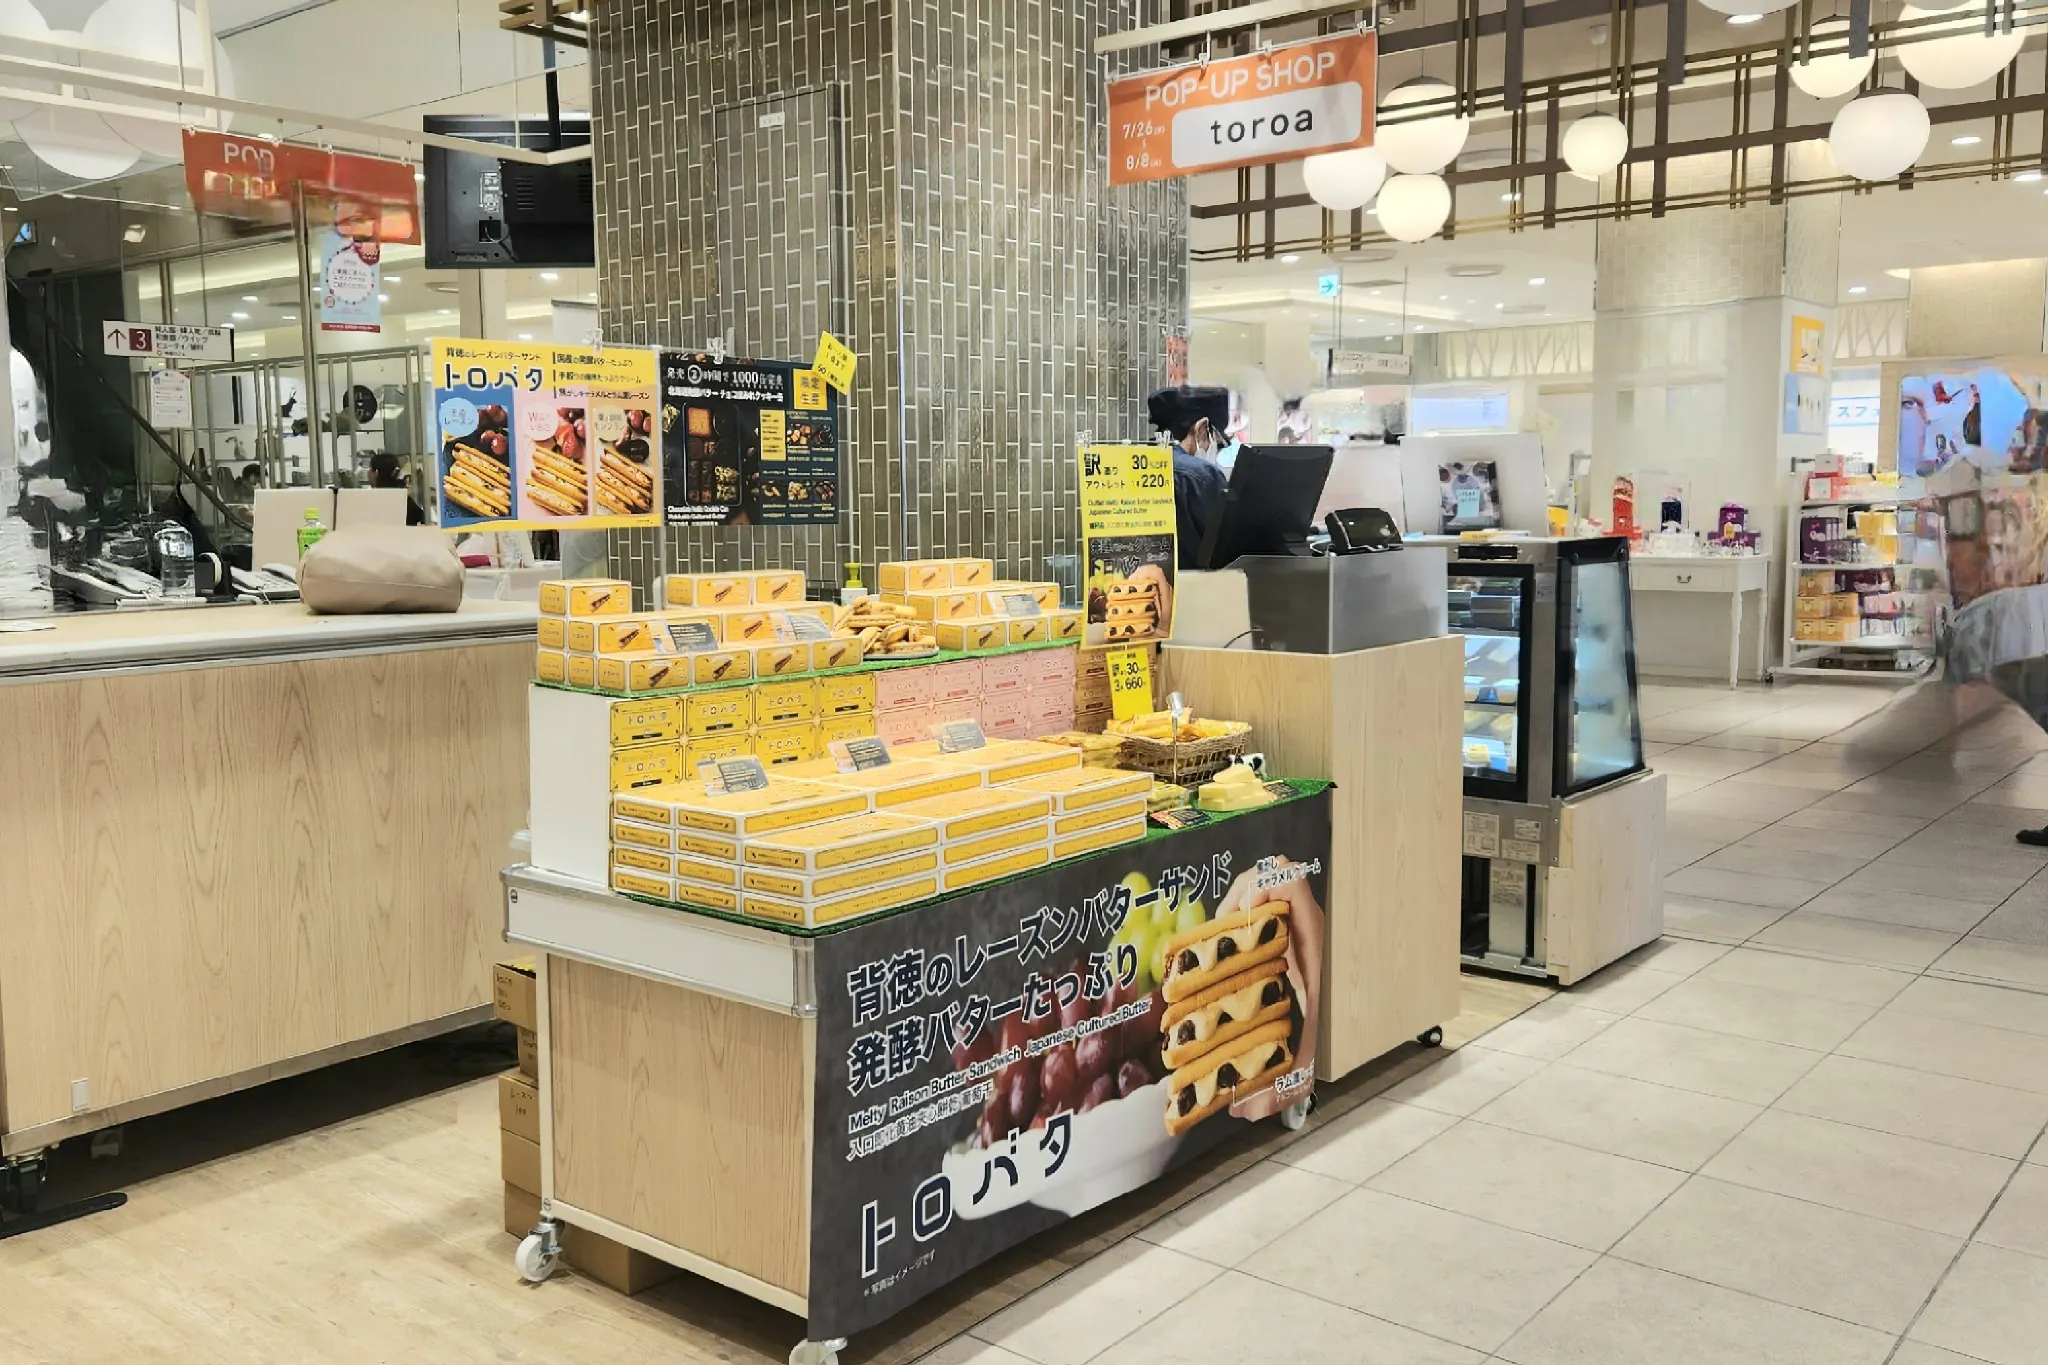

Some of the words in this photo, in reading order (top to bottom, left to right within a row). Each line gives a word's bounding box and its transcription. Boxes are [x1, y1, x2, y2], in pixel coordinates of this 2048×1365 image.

[1145, 68, 1249, 110] POP-UP
[1256, 51, 1336, 91] SHOP
[1210, 108, 1313, 145] toroa
[135, 331, 147, 350] 3
[444, 362, 544, 392] トロバタ
[846, 851, 1233, 1027] 背徳のレーズンバターサンド
[846, 943, 1139, 1096] 発酵バターたっぷり
[848, 1102, 888, 1134] Melty
[889, 1086, 931, 1116] Raison
[929, 1069, 968, 1098] Butter
[968, 1045, 1021, 1080] Sandwich
[1024, 1030, 1076, 1057] Japanese
[1075, 1012, 1123, 1040] Cultured
[1122, 998, 1153, 1020] Butter
[861, 1108, 1074, 1279] トロバタ
